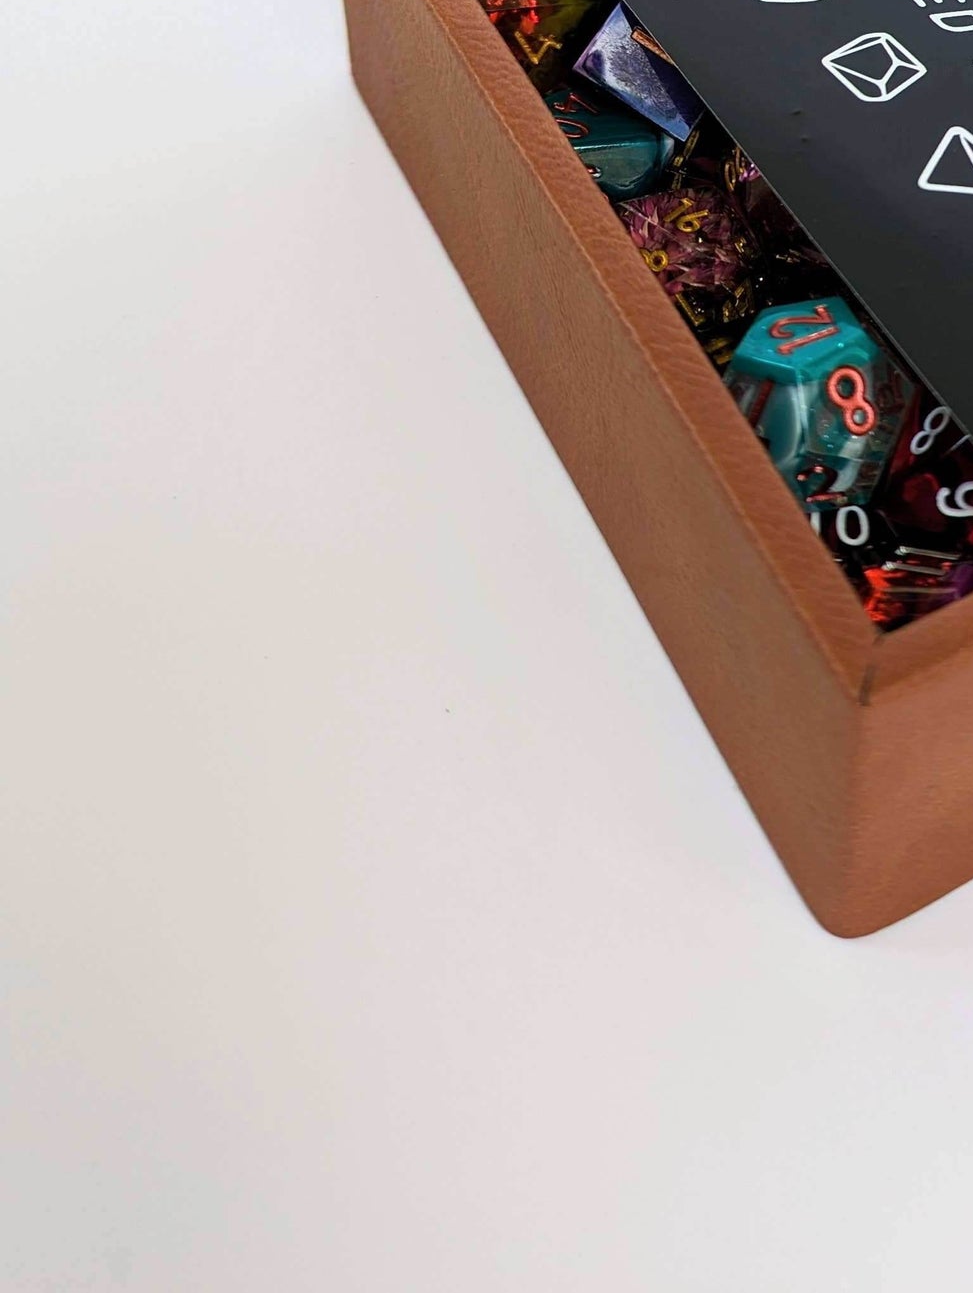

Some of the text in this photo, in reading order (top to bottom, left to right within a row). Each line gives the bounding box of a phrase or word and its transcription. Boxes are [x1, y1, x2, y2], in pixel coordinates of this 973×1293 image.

[664, 197, 710, 233] 16
[769, 304, 840, 356] 12
[826, 365, 876, 436] 8
